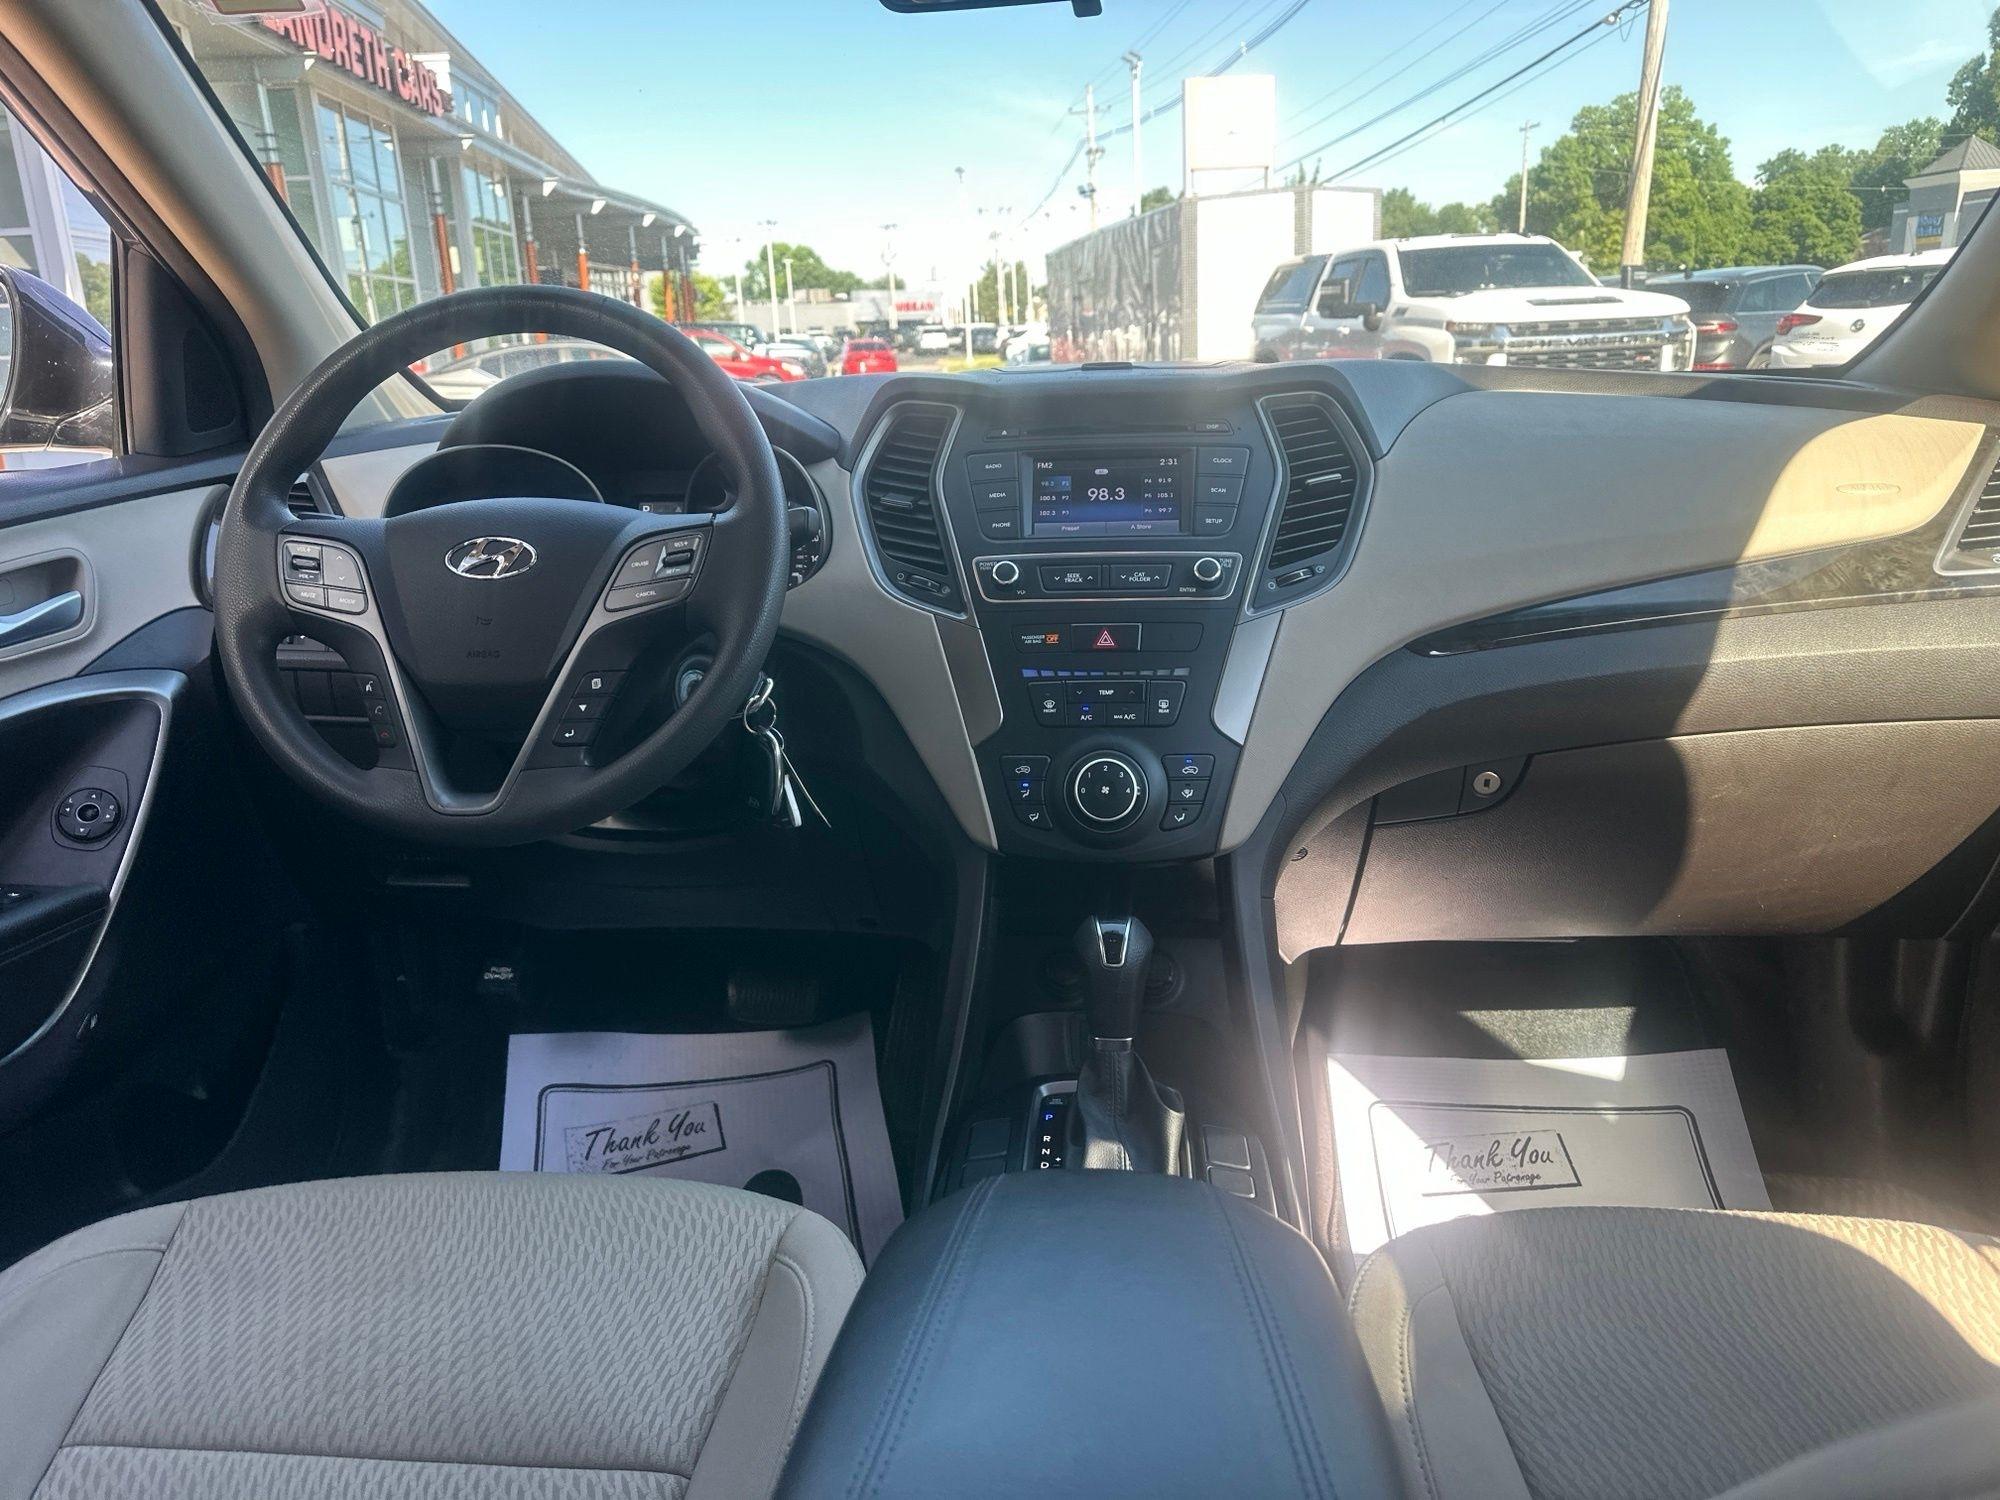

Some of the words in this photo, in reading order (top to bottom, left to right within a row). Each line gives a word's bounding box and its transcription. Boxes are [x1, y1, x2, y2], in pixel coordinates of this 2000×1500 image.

[393, 47, 445, 117] CARS
[1159, 458, 1178, 466] 2:31
[1087, 487, 1125, 501] 98.3
[635, 589, 657, 598] CANCEL
[1046, 635, 1059, 643] OFF
[585, 1118, 661, 1161] Thank
[668, 1110, 706, 1142] You
[602, 1158, 619, 1170] For
[622, 1154, 646, 1166] Your
[646, 1144, 692, 1160] Patronage
[1424, 1139, 1504, 1172] Thank
[1510, 1135, 1554, 1168] You
[1040, 1161, 1050, 1169] D
[1468, 1174, 1491, 1184] Your
[1493, 1171, 1542, 1186] Patronage
